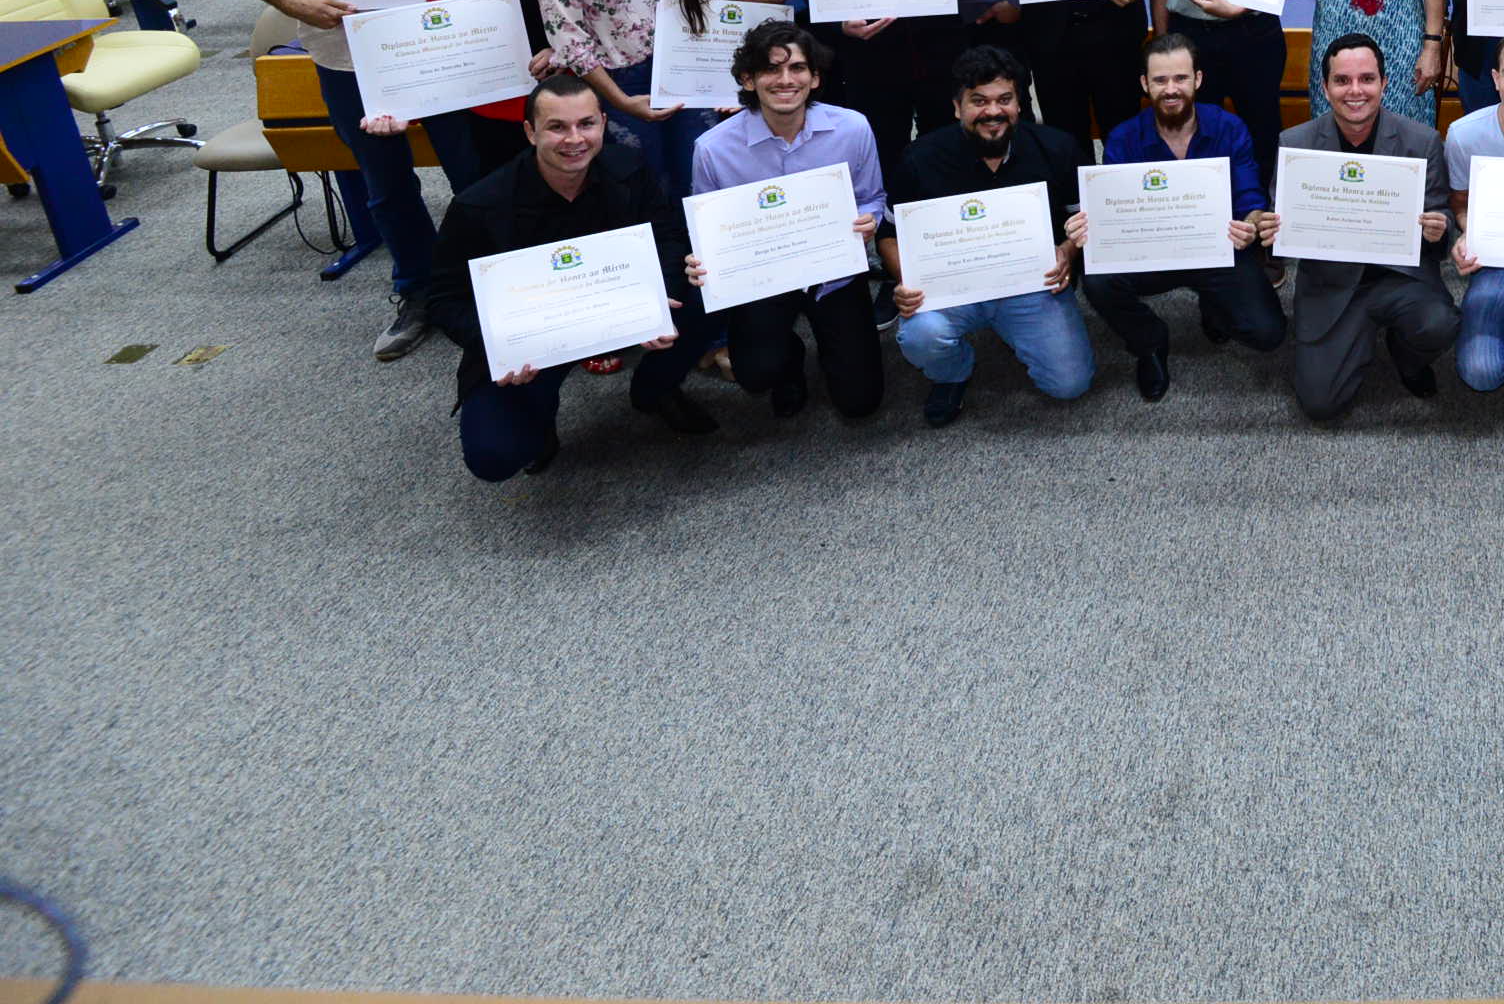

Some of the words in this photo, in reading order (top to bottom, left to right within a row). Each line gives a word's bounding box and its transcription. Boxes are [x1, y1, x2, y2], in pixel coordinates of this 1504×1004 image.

[1302, 183, 1330, 193] Diploma
[1342, 187, 1364, 195] Honra
[1377, 189, 1400, 198] Mérito
